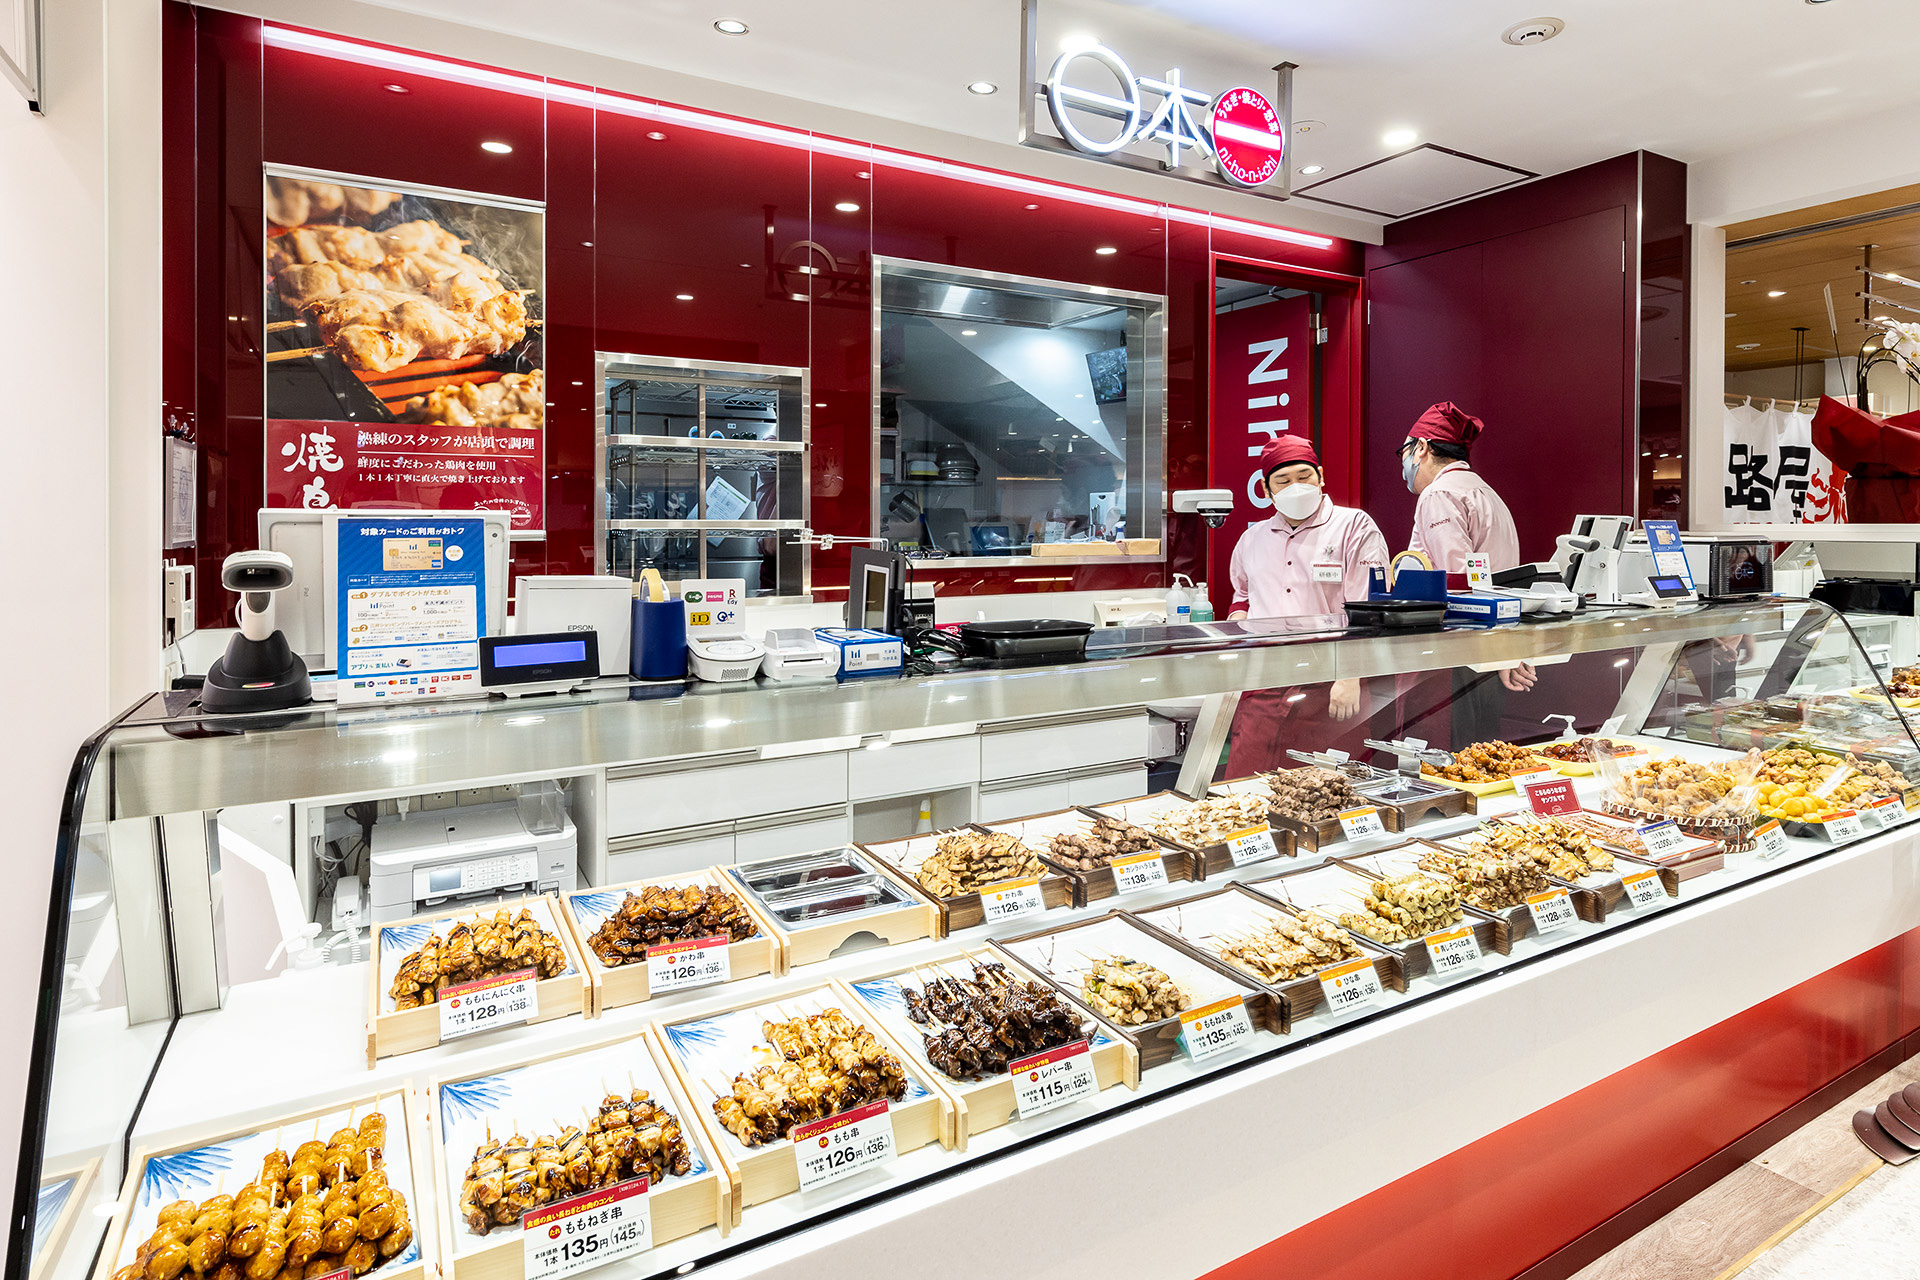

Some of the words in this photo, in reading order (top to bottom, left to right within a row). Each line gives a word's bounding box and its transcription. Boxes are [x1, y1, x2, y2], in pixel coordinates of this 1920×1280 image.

[357, 430, 535, 450] 熟練のスタッフが店頭で調理
[357, 457, 496, 471] 鮮度にこだわった鶏肉を使用
[360, 527, 465, 536] 対象カードのご利用がおトク
[679, 951, 705, 963] かわ串
[465, 984, 526, 1006] ももにんにく串
[1204, 1011, 1234, 1028] ももねぎ串
[1041, 1061, 1073, 1079] レバー串
[1029, 1095, 1039, 1103] 1本
[834, 1127, 860, 1144] もも串
[813, 1164, 825, 1174] 1本
[526, 1194, 615, 1229] 食感の良い長ねぎとお肉のコンビ
[565, 1206, 623, 1235] ももねぎ串
[534, 1247, 559, 1260] 本体価格
[543, 1254, 559, 1267] 1本
